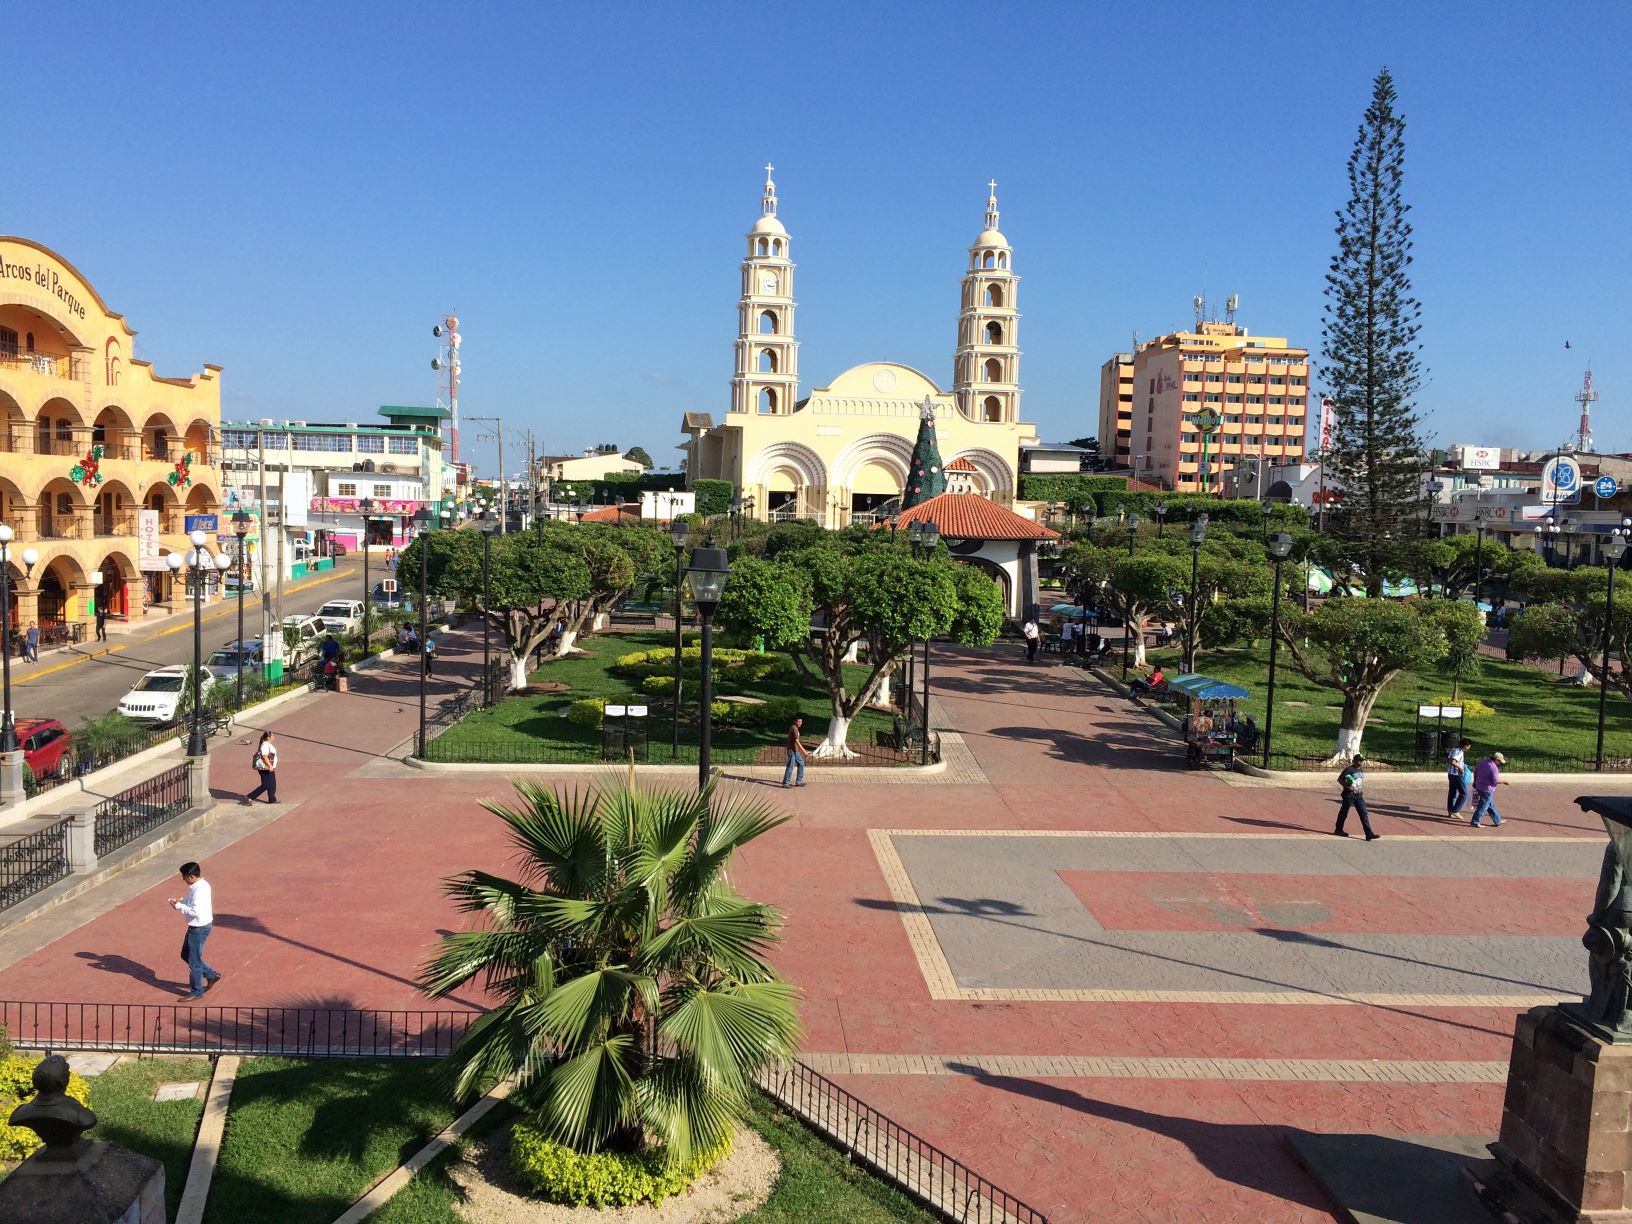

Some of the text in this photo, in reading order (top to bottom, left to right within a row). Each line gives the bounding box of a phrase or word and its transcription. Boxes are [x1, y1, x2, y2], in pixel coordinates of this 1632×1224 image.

[35, 264, 50, 291] del
[52, 271, 86, 320] Parque
[1470, 459, 1494, 467] HSBC
[1600, 481, 1613, 490] 24
[1476, 506, 1496, 518] HSBC
[145, 519, 154, 557] HOTEL
